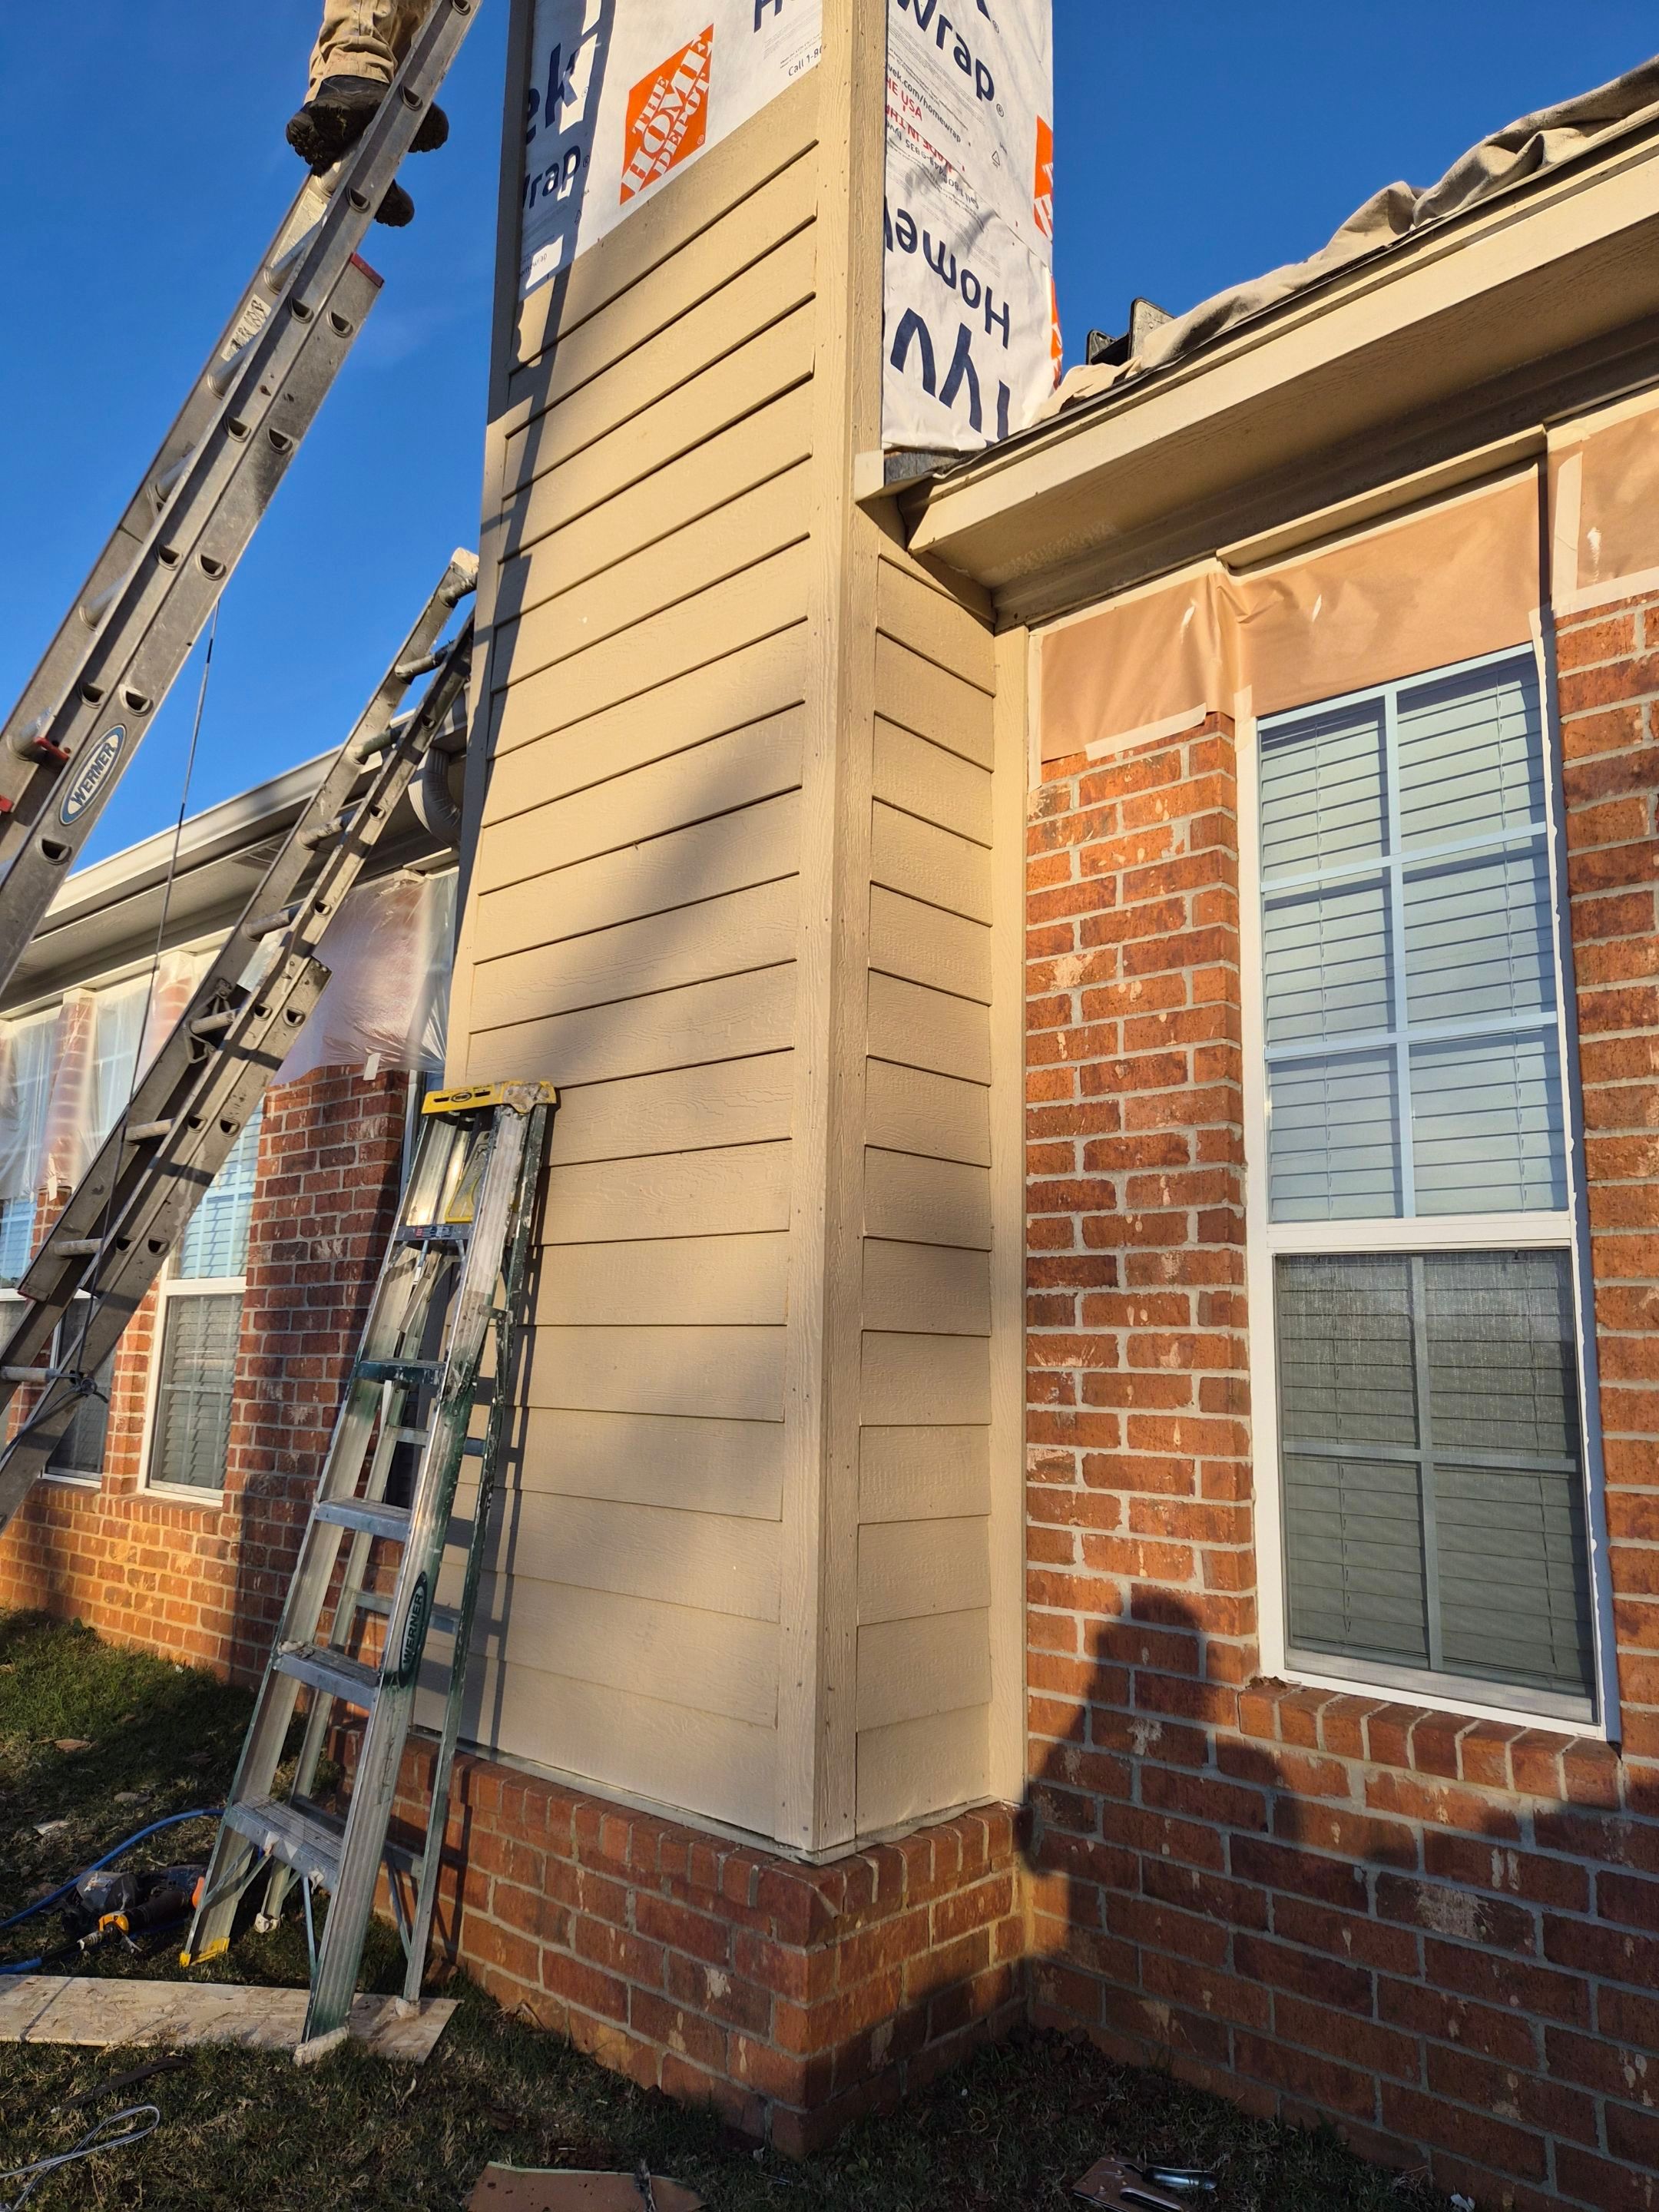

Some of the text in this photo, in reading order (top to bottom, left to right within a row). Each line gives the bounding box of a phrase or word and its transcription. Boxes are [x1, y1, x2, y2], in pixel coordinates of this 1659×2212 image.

[788, 58, 804, 76] Call
[621, 35, 714, 194] HOME
[631, 75, 669, 134] THE
[654, 72, 710, 175] DEPOT
[901, 90, 923, 121] USA
[523, 145, 581, 210] rap
[883, 194, 1010, 350] Home
[69, 742, 116, 806] WERNER
[403, 1593, 423, 1665] WERNER
